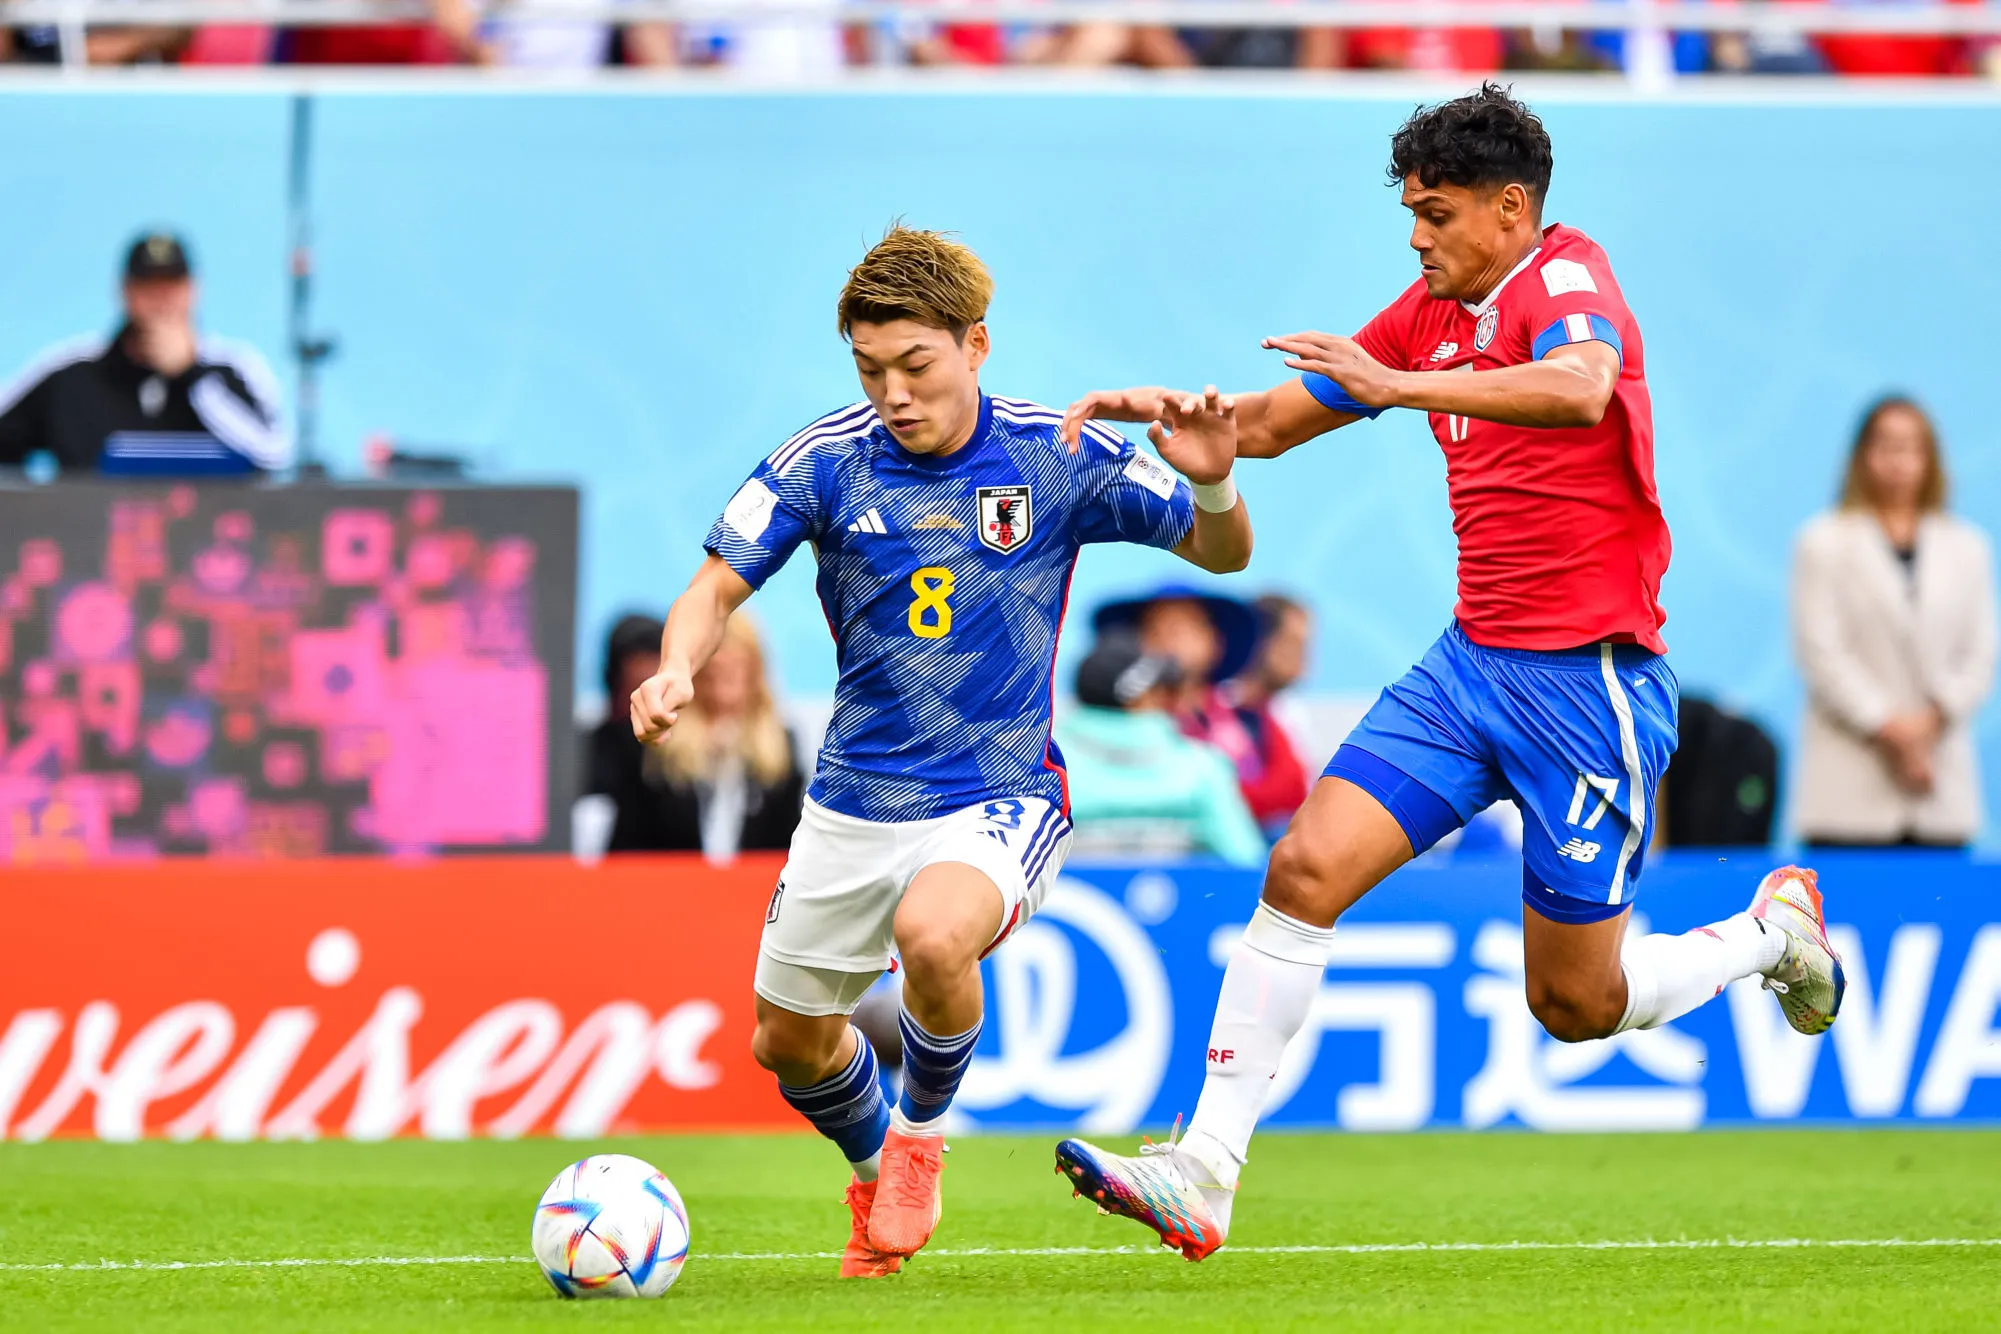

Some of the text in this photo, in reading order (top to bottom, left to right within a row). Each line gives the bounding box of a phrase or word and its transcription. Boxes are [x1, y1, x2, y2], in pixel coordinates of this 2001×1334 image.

[989, 488, 1018, 496] JAPAN
[994, 530, 1017, 542] JFA
[907, 566, 956, 639] 8
[1565, 770, 1620, 831] 17
